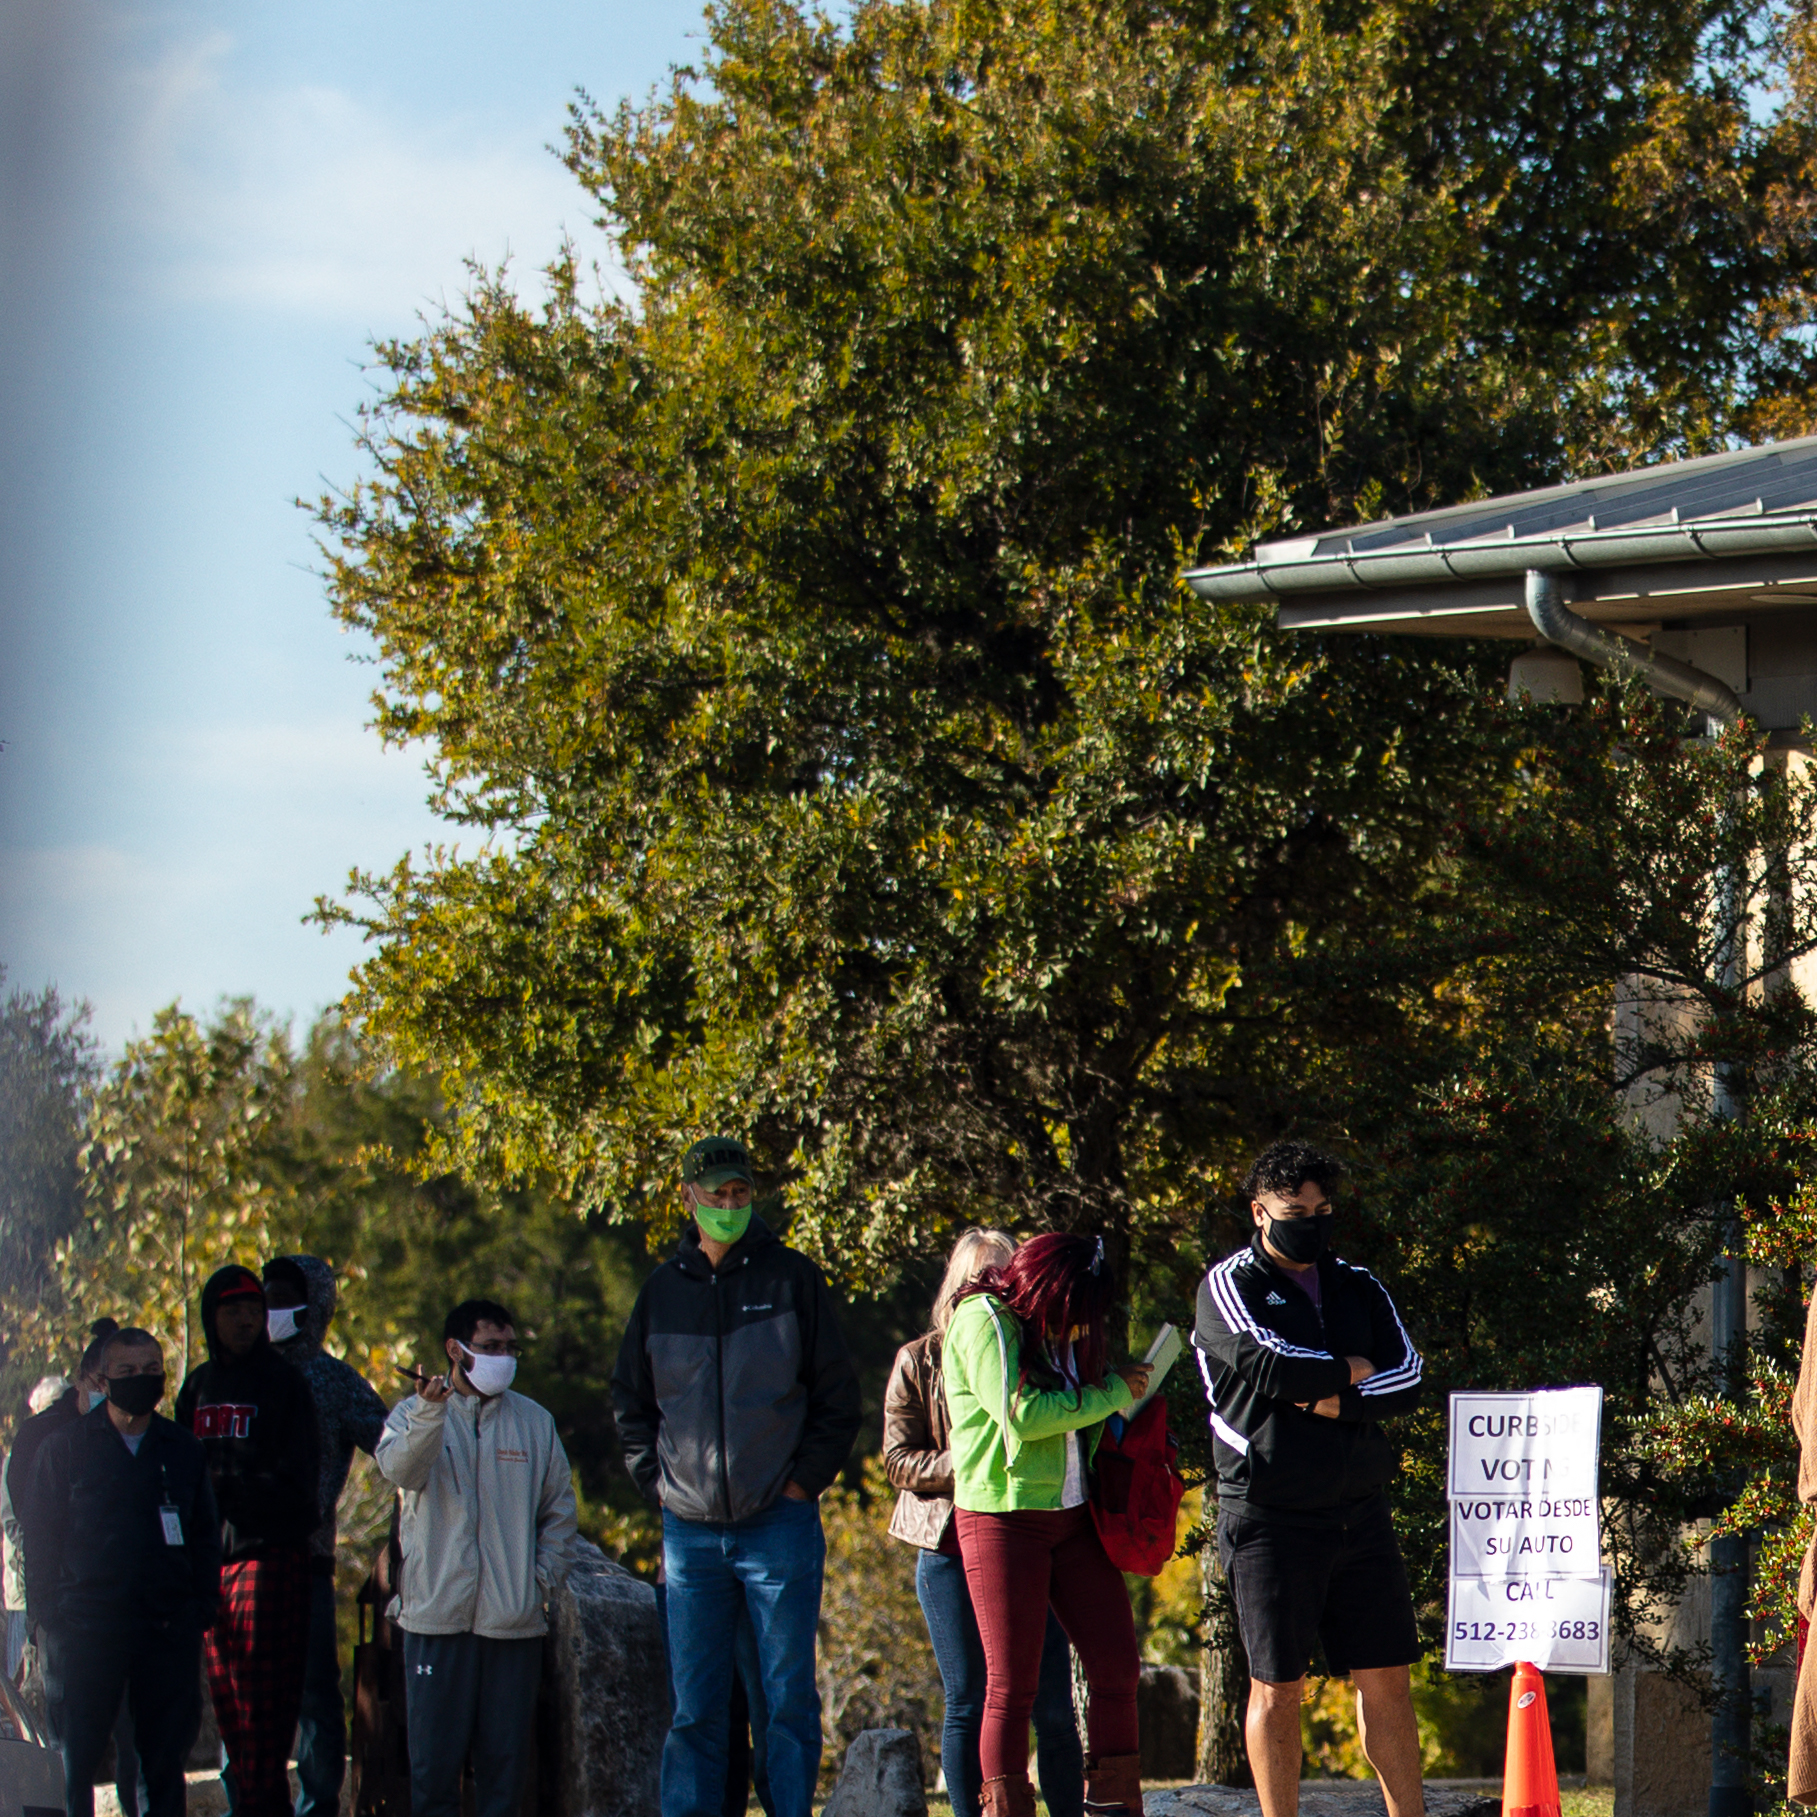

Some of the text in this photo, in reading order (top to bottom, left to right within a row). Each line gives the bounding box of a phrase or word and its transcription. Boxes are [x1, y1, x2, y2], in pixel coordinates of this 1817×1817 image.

[1468, 1413, 1581, 1438] CURBSIDE
[1481, 1457, 1570, 1481] VOTNG
[1458, 1499, 1592, 1521] VOTAR DESDE
[1486, 1534, 1573, 1555] SU AUTO
[1506, 1580, 1554, 1601] CALL
